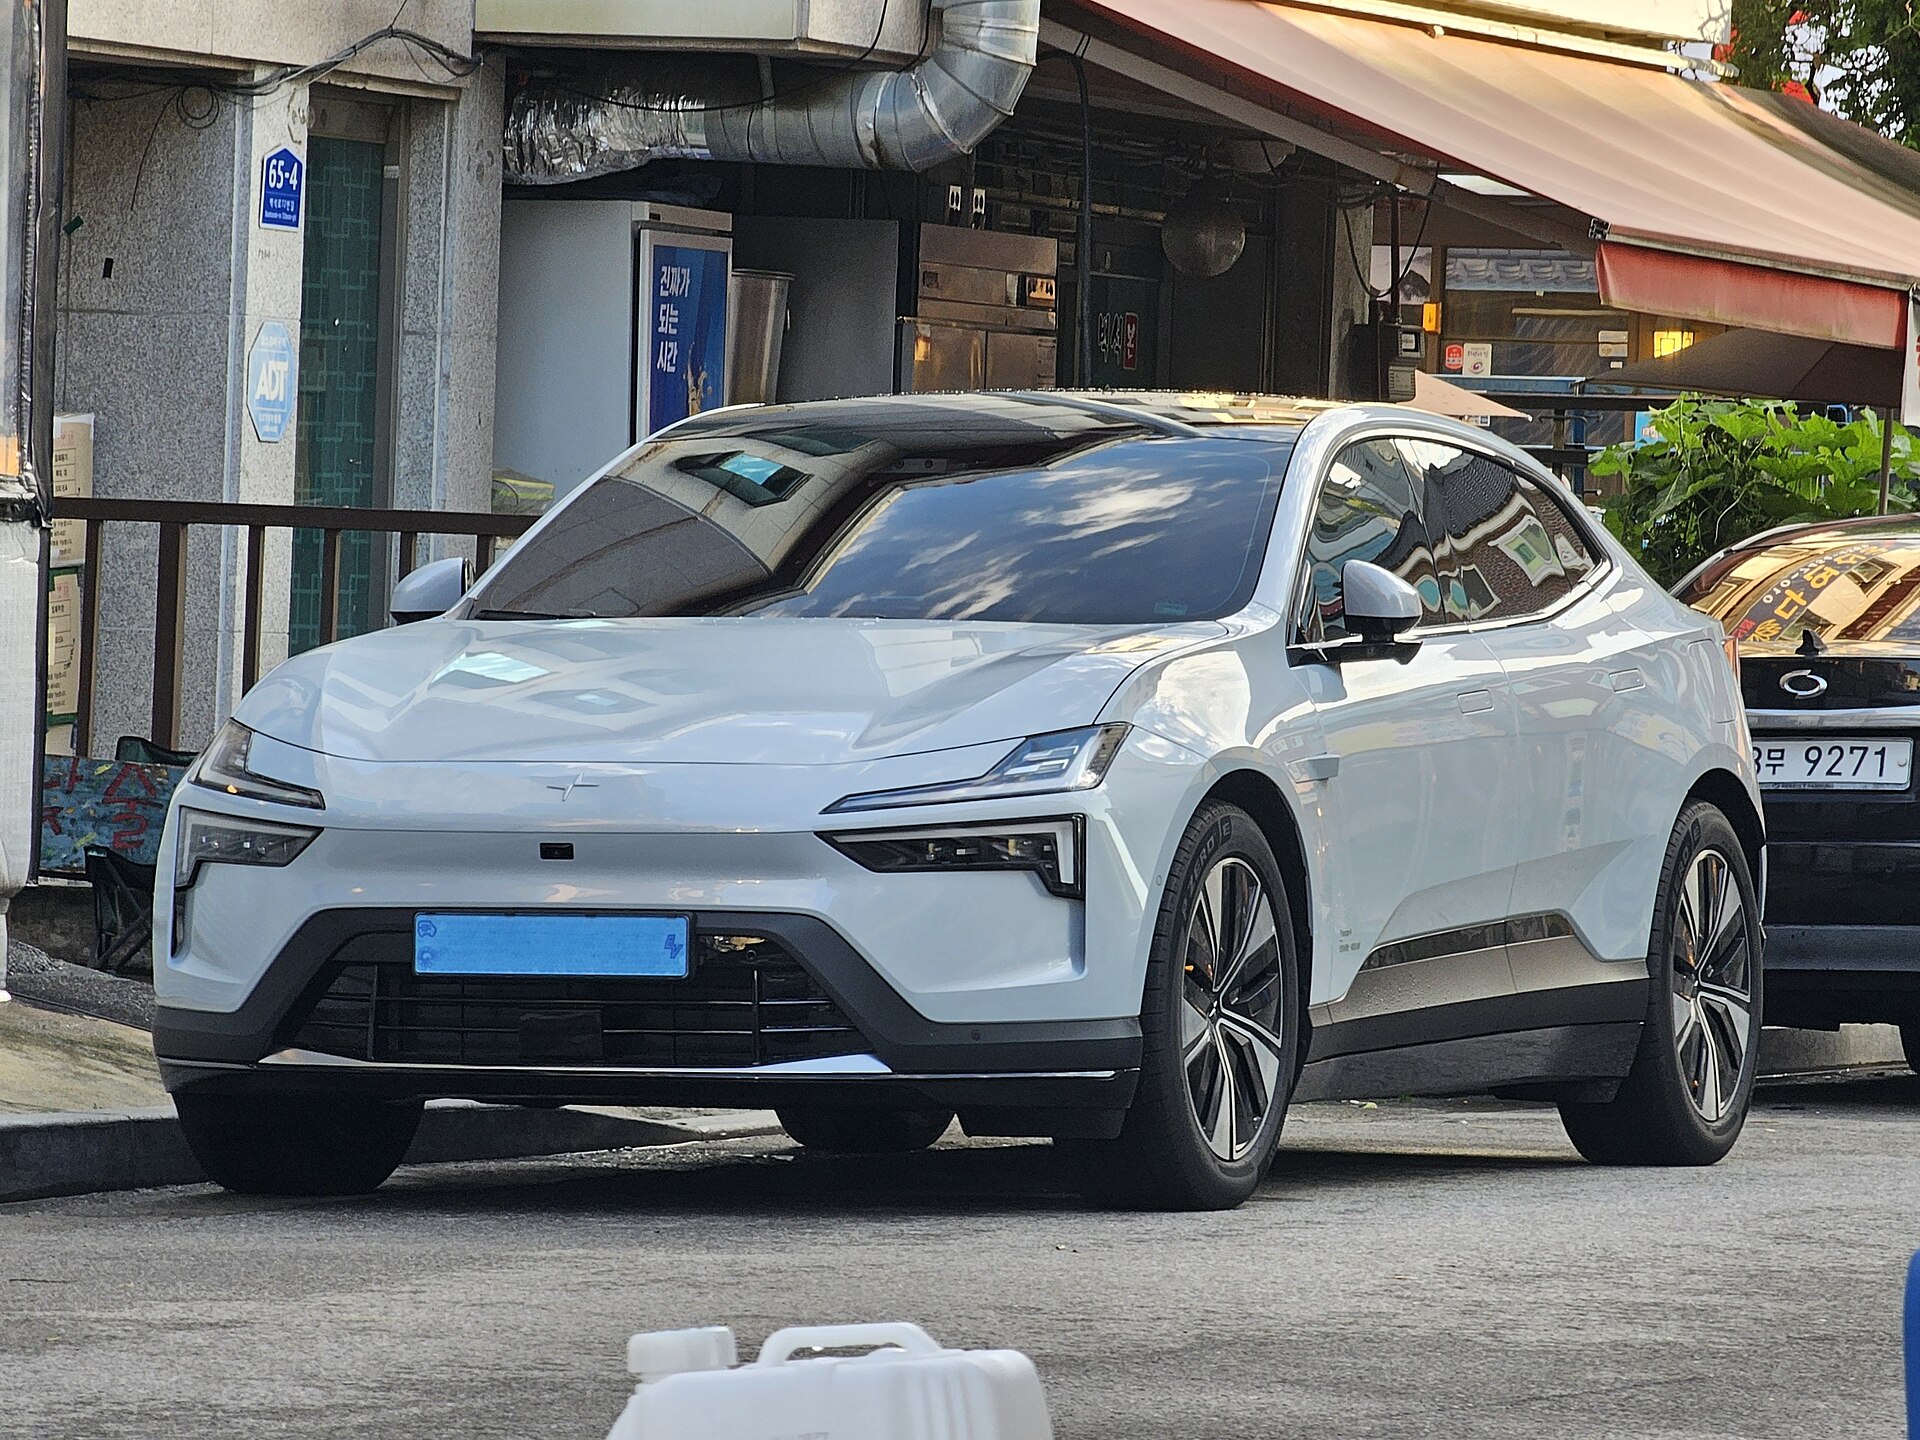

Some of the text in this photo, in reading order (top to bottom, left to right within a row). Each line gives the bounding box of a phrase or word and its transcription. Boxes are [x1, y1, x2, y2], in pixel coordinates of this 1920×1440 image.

[268, 158, 299, 191] 65-4
[660, 265, 690, 298] 진짜가
[658, 303, 679, 335] 되는
[656, 340, 678, 373] 시간
[255, 361, 289, 402] ADT
[1804, 745, 1887, 777] 9271
